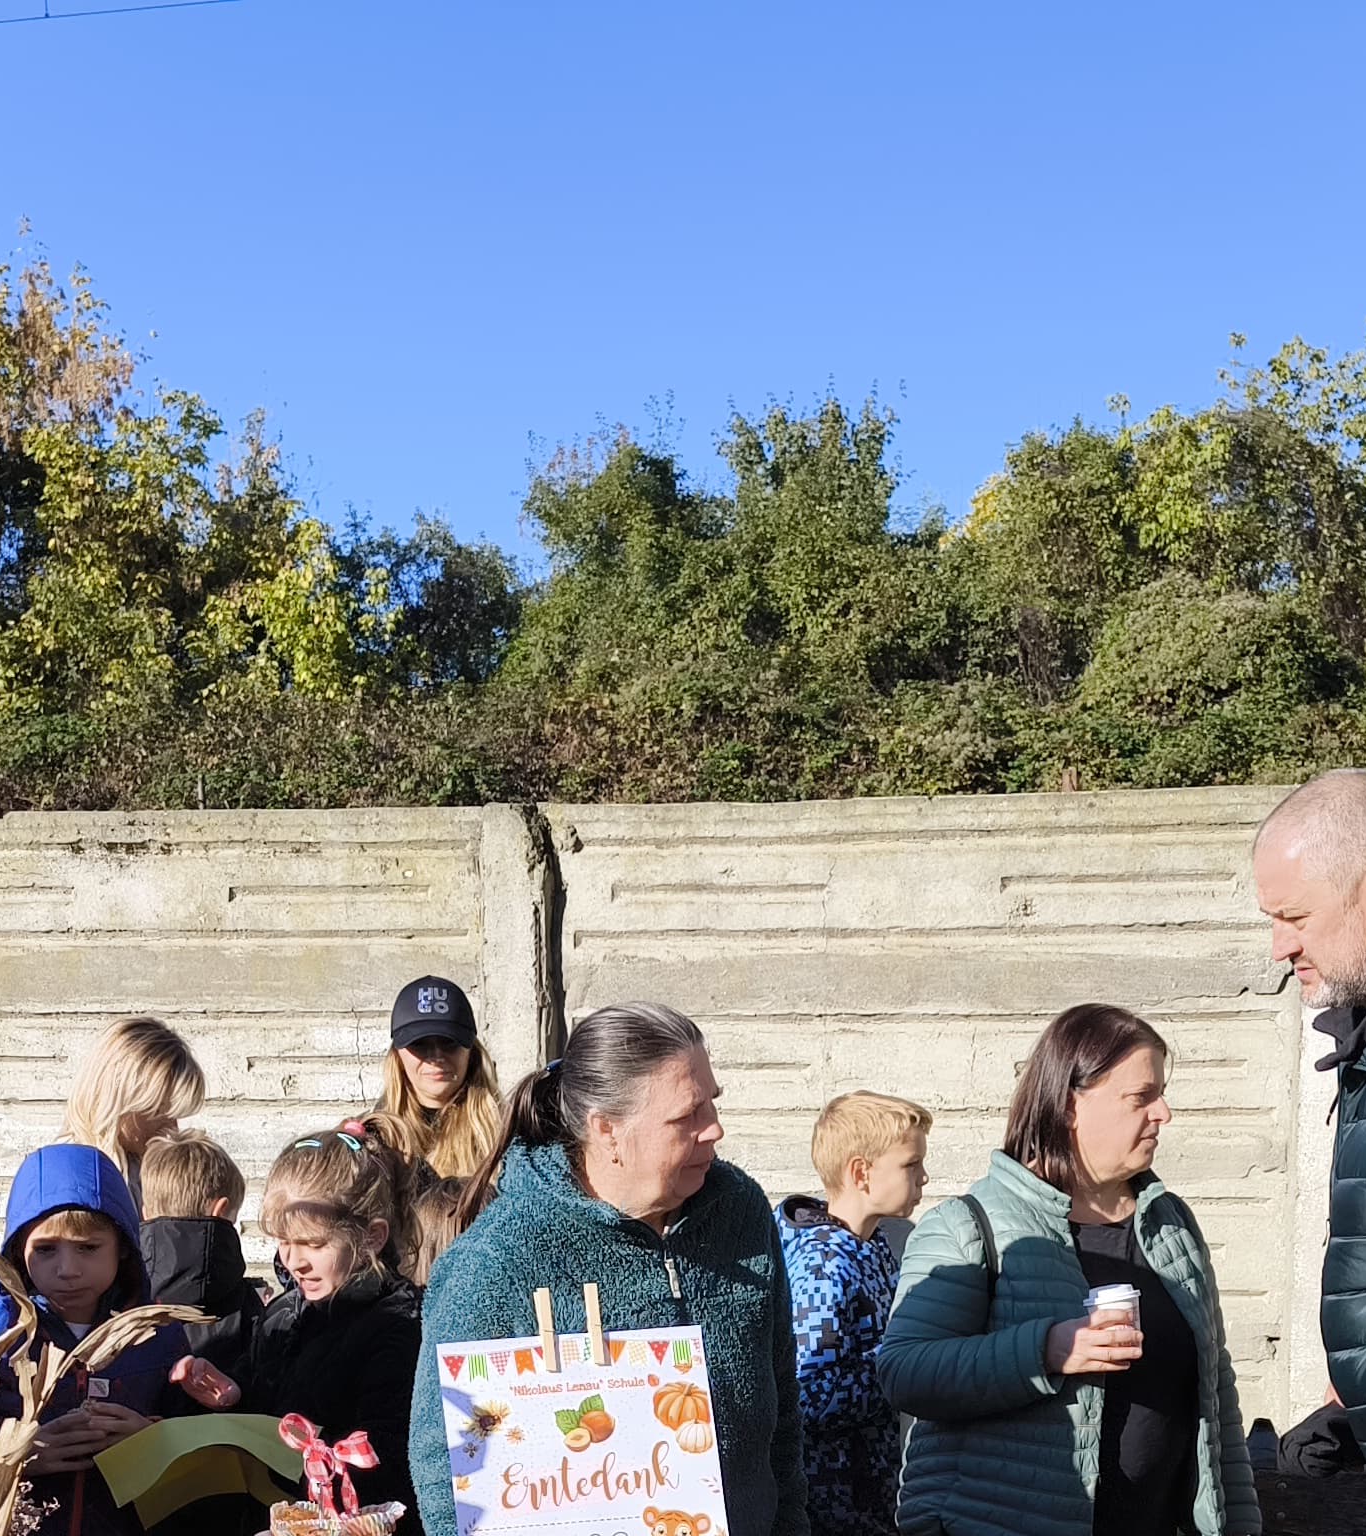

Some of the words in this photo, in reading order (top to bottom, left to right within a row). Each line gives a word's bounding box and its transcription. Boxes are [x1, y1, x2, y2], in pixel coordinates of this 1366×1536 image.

[418, 986, 448, 1000] HU
[417, 1001, 450, 1013] GO
[500, 1440, 680, 1512] Erntedank
